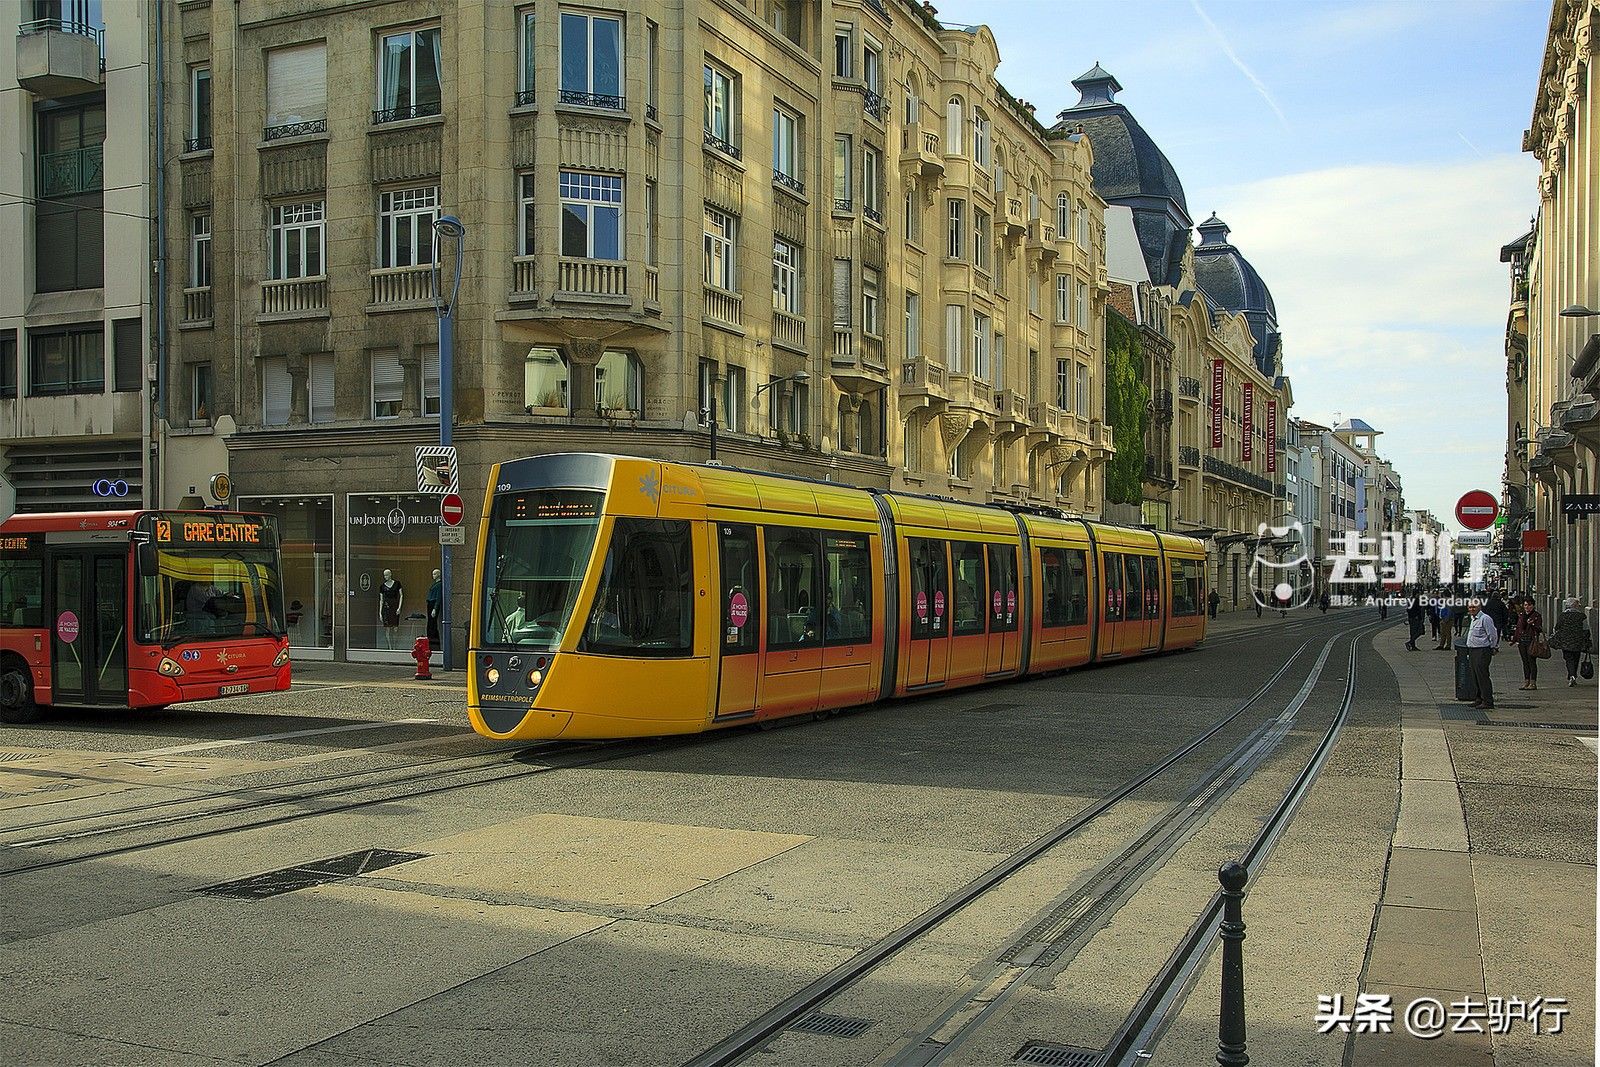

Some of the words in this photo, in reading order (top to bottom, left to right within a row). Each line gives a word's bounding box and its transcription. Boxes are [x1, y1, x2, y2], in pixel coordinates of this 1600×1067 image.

[1214, 364, 1222, 405] LAFAYETTE
[1214, 407, 1222, 443] GALERIES
[496, 483, 511, 491] 109
[363, 513, 386, 527] JOUR
[407, 515, 443, 525] AILLEUR
[158, 522, 169, 541] 2
[183, 522, 215, 542] GARE
[215, 523, 260, 543] CENTRE
[723, 527, 732, 536] 109
